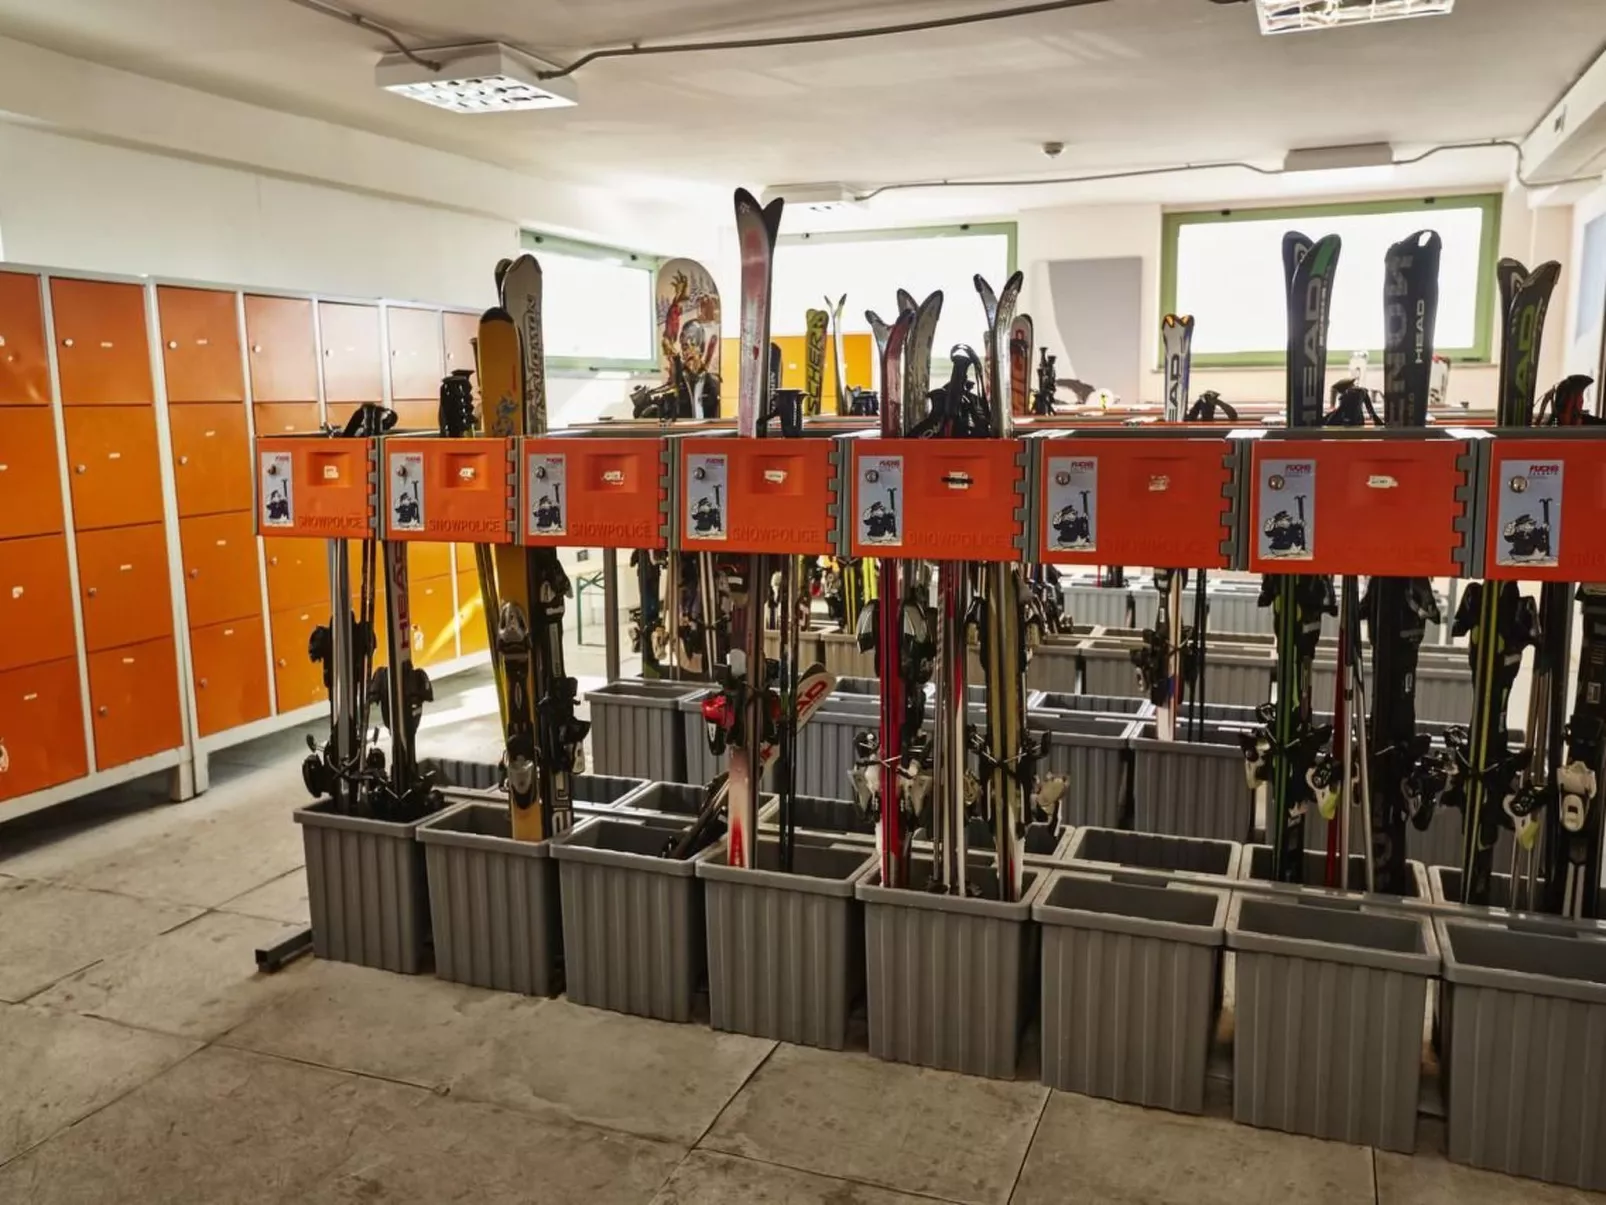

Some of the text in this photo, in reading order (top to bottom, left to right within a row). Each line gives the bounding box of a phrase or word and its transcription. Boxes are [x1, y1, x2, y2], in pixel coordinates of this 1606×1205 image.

[1413, 299, 1425, 364] HEAD
[1285, 464, 1311, 472] FUCHS
[1530, 464, 1559, 472] FUCHS
[299, 515, 364, 529] SNOWPOLICE
[428, 519, 502, 533] SNOWPOLICE
[571, 521, 652, 538] SNOWPOLICE
[732, 527, 820, 543] SNOWPOLICE
